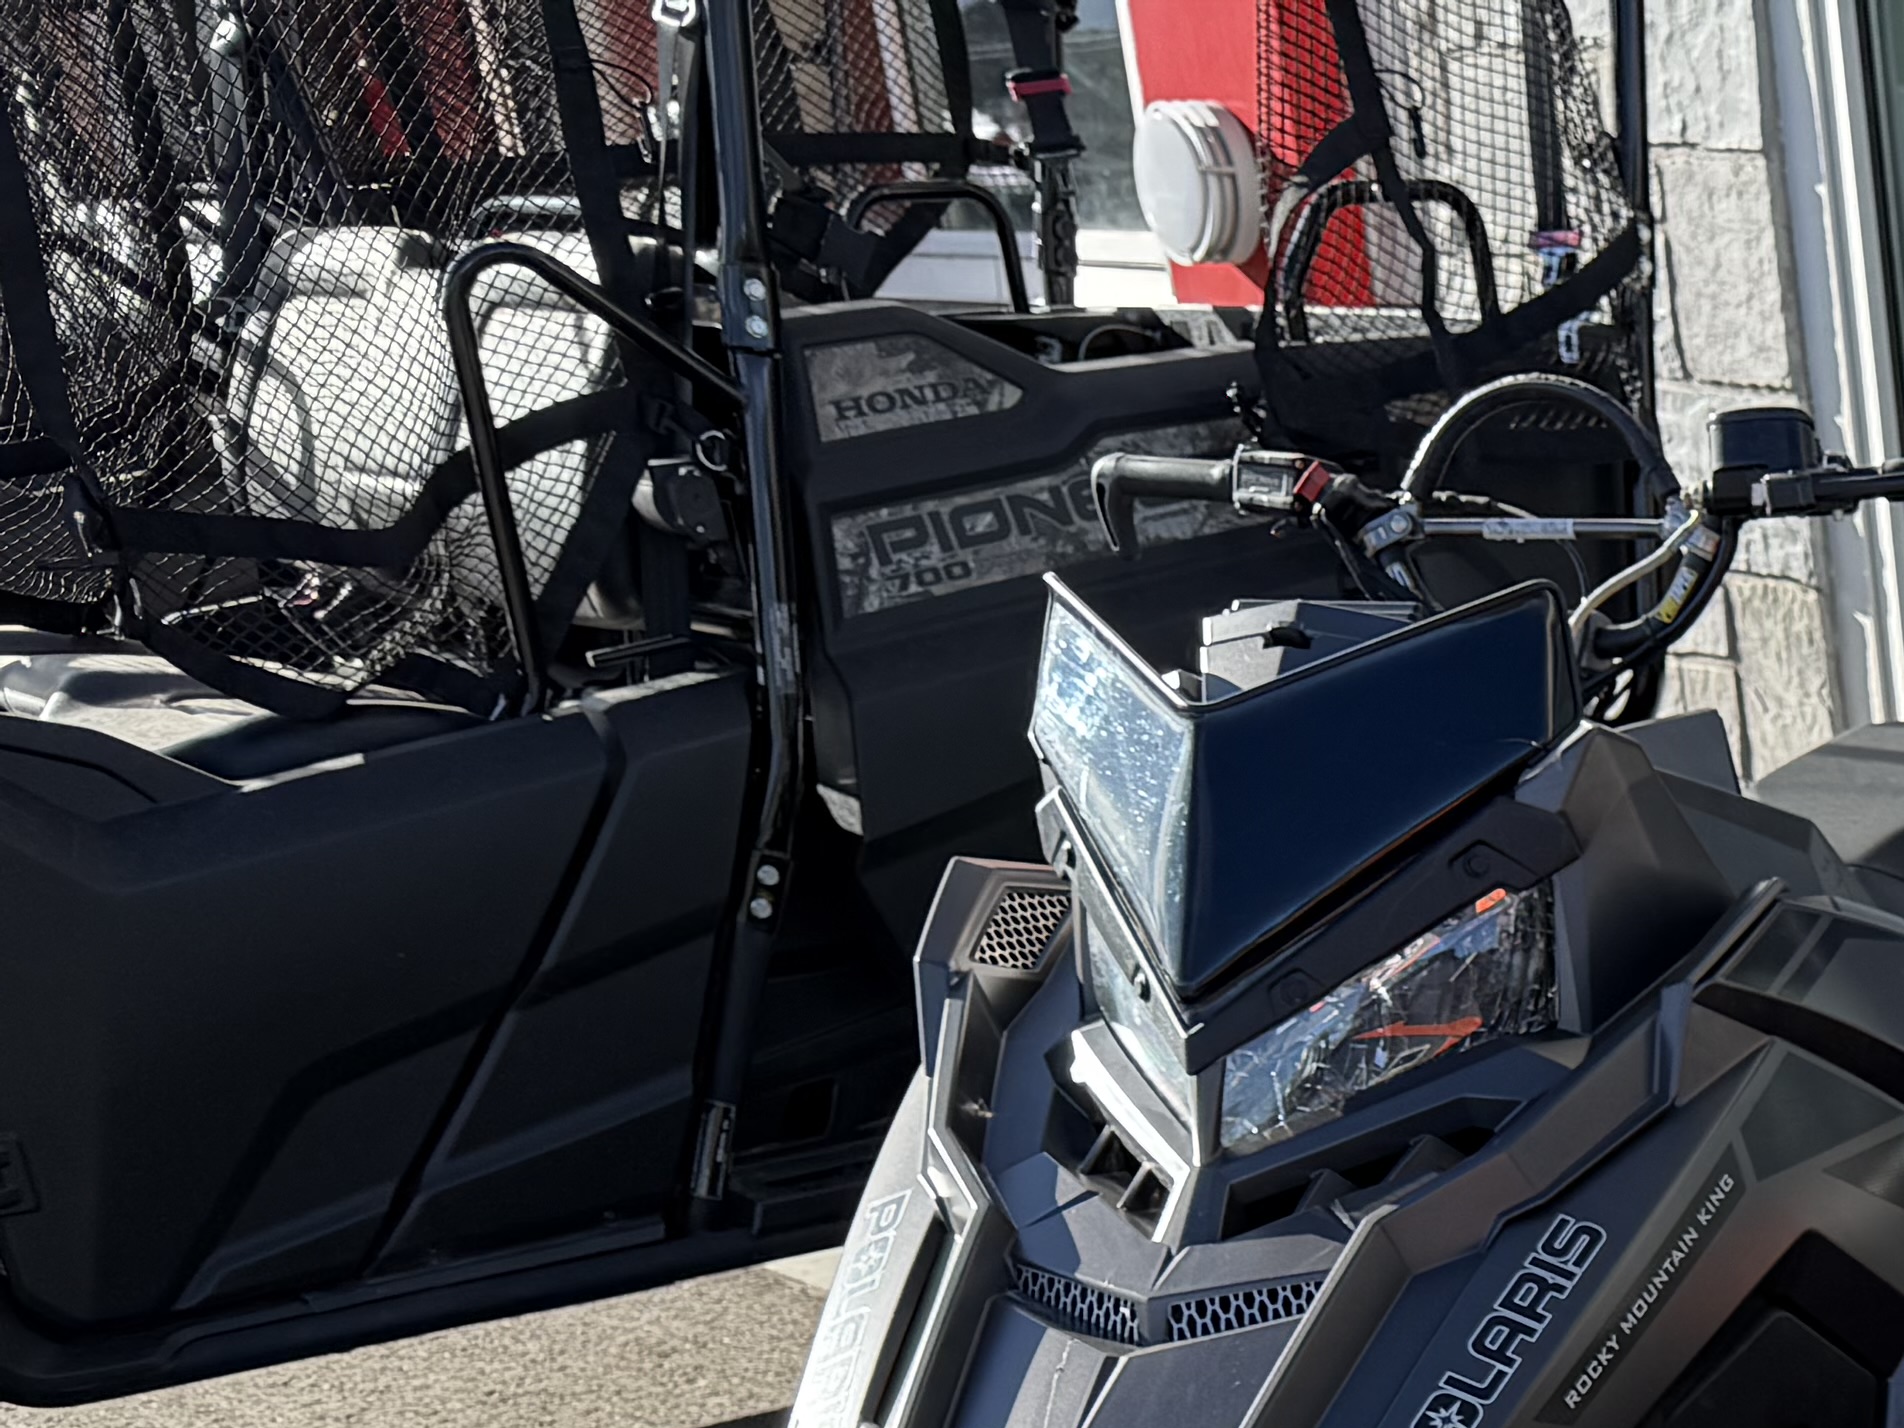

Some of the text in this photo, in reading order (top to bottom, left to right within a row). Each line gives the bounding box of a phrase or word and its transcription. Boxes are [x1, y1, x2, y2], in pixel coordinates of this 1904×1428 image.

[830, 376, 991, 421] HONDA
[865, 474, 1100, 567] PIONE
[882, 560, 972, 593] 700
[1564, 1173, 1735, 1409] ROCKY MOUNTAIN KING
